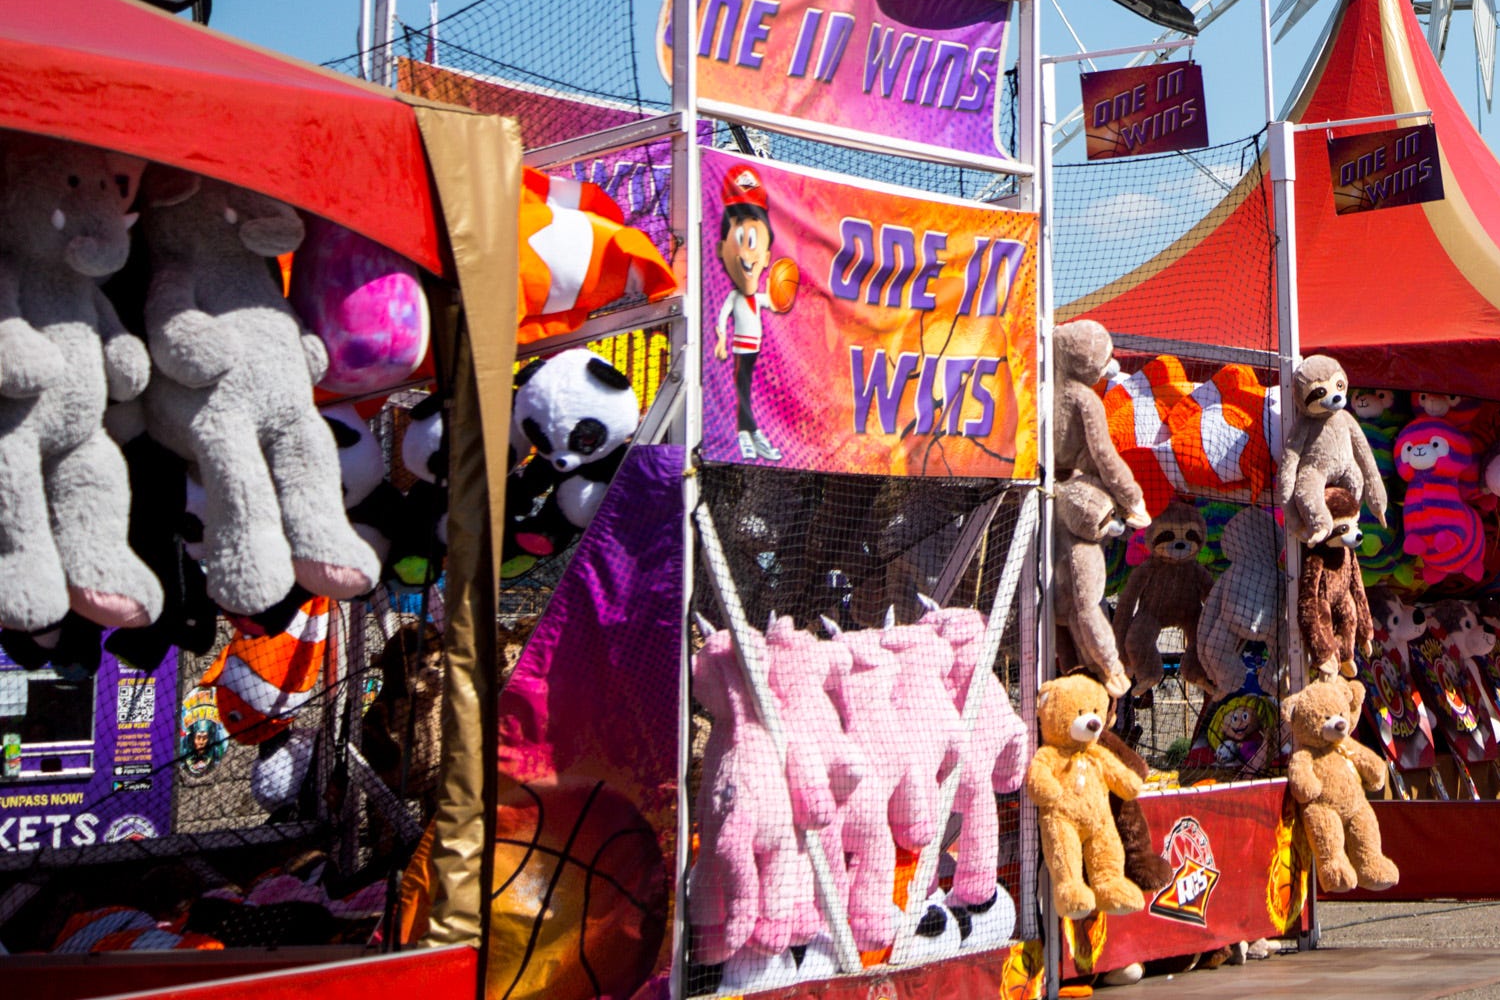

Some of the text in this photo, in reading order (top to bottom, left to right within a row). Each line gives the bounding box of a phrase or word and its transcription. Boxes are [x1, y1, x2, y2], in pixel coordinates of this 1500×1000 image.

[828, 216, 948, 311] ONE
[0, 792, 84, 808] UNPASS NOW!
[1175, 866, 1208, 906] RCS
